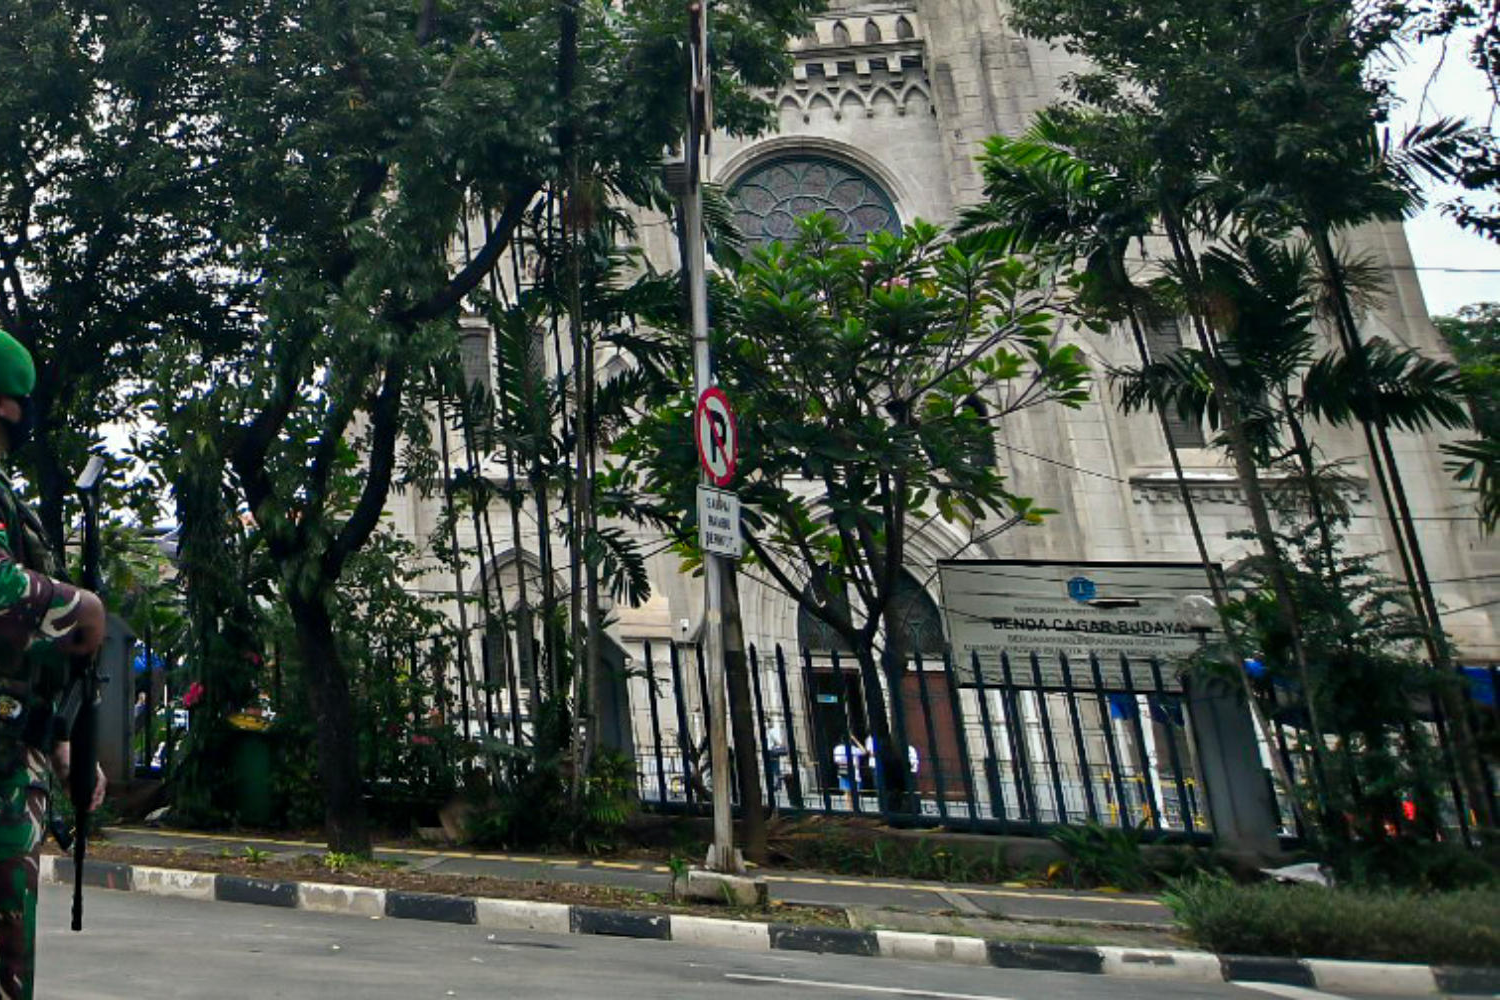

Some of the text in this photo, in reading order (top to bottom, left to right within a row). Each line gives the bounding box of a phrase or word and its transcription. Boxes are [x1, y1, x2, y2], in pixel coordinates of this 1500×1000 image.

[710, 410, 727, 463] P
[993, 617, 1048, 632] BENDA
[1117, 620, 1187, 634] BUDAYA
